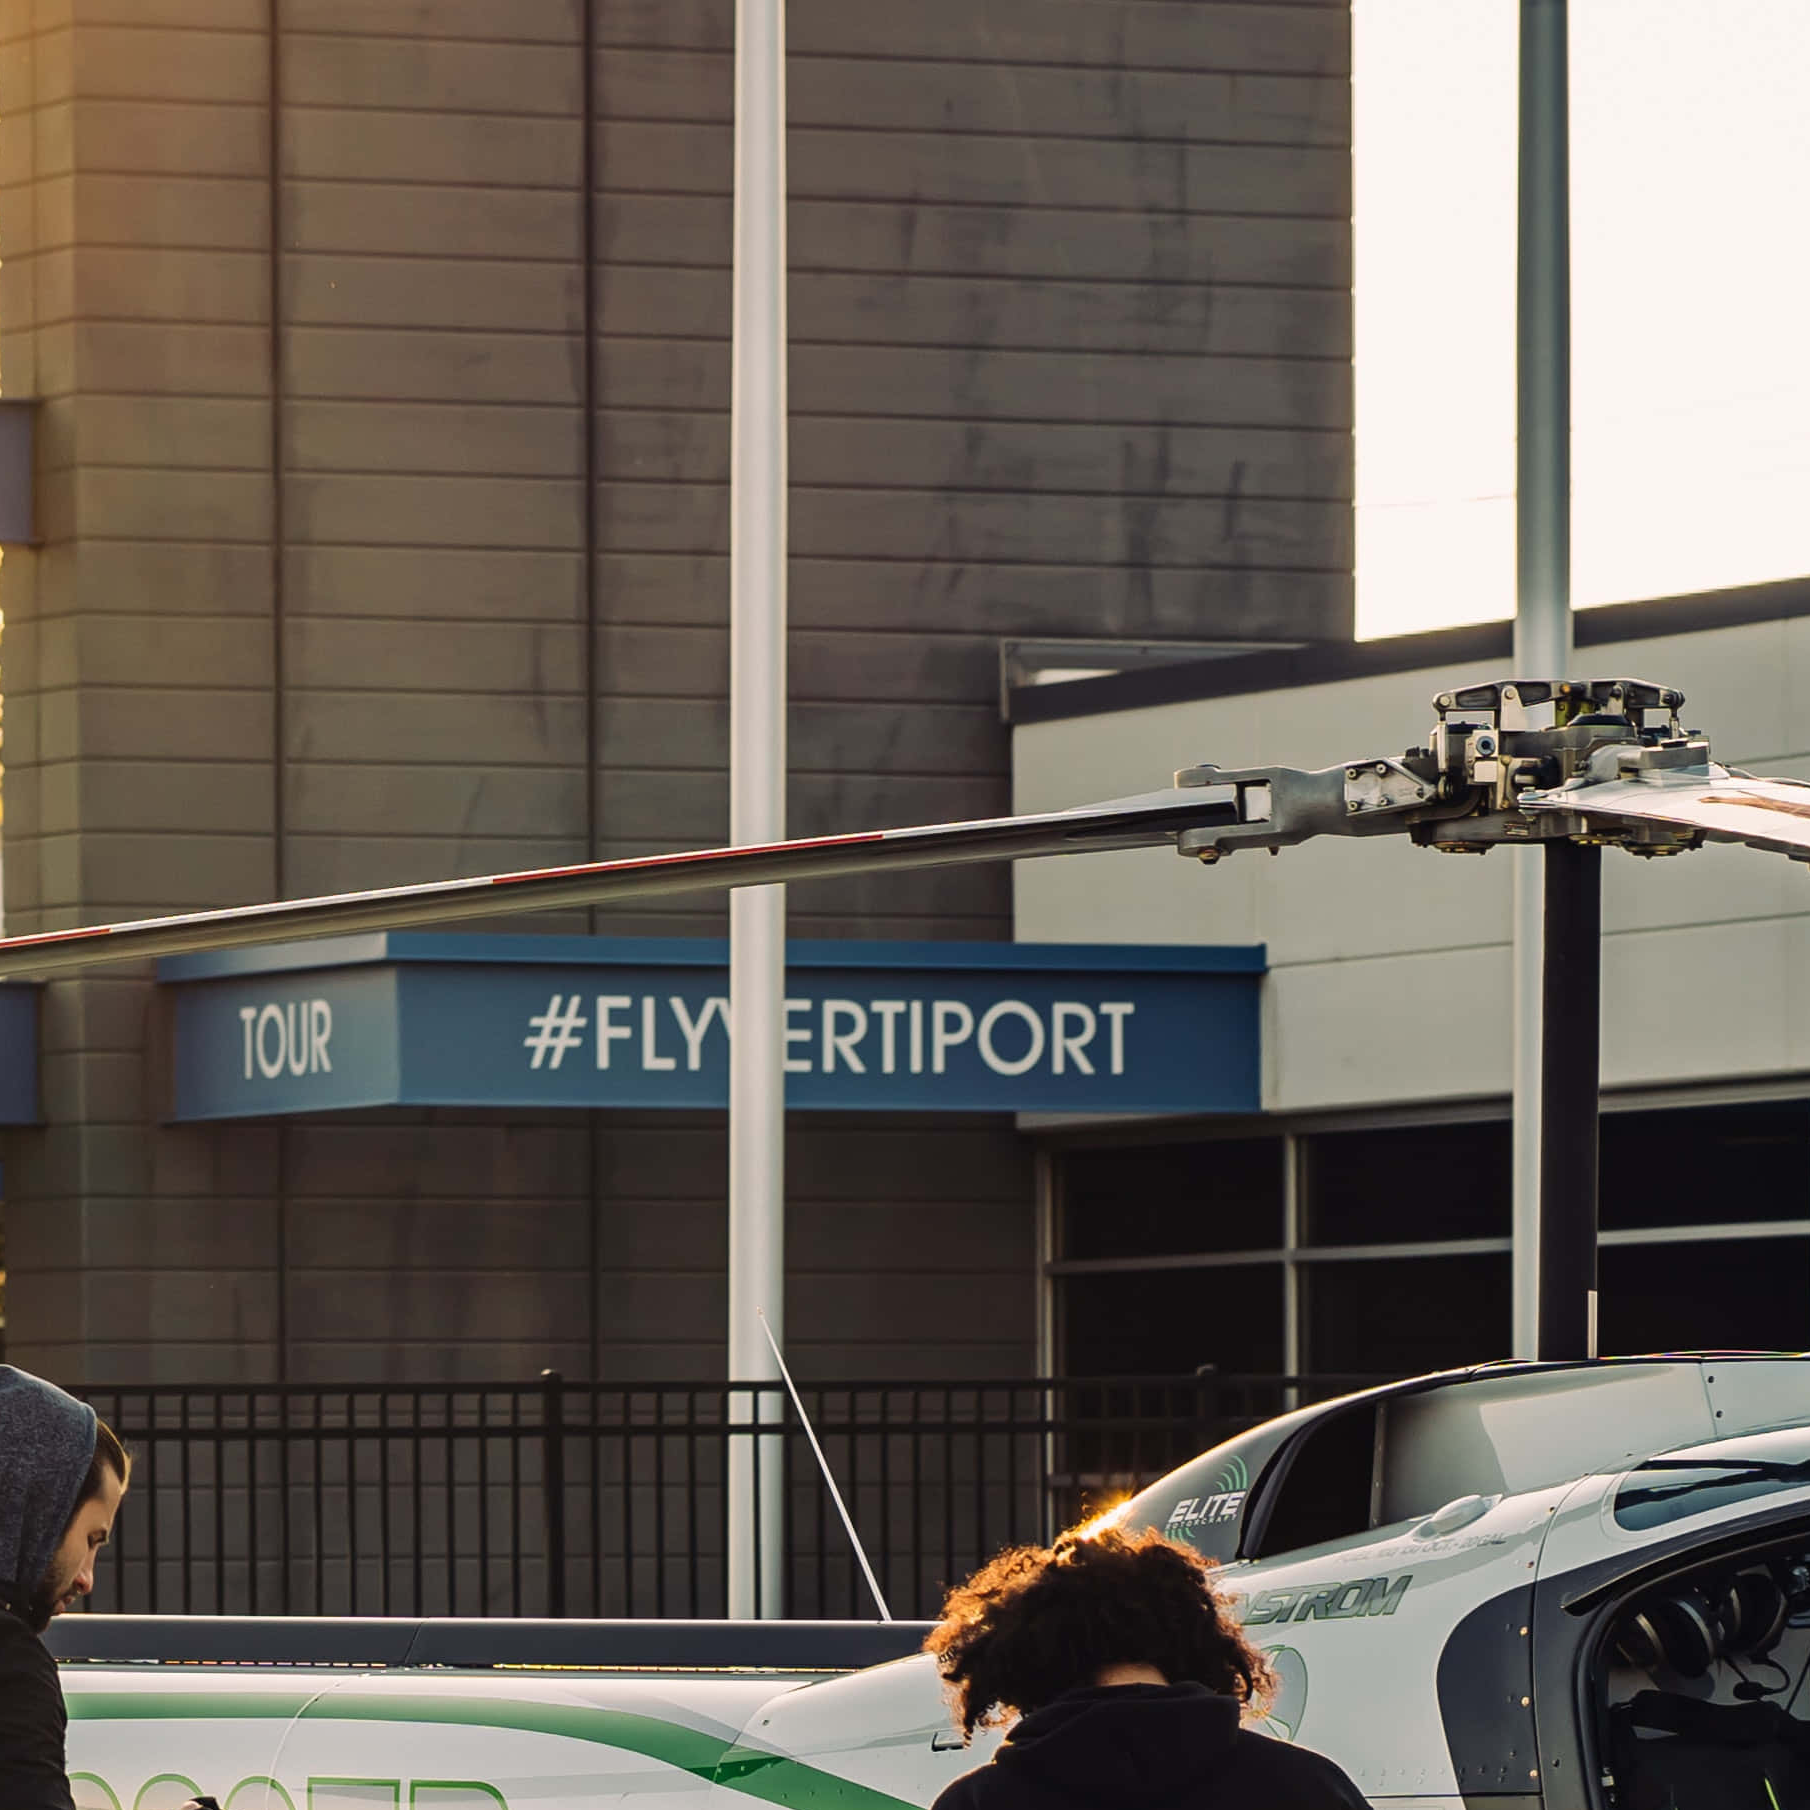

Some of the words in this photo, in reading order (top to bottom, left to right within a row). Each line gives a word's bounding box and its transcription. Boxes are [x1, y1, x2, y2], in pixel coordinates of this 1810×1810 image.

[239, 999, 332, 1081] TOUR
[523, 995, 1135, 1076] #FLYERTIPORT
[1169, 1490, 1246, 1524] ELITE
